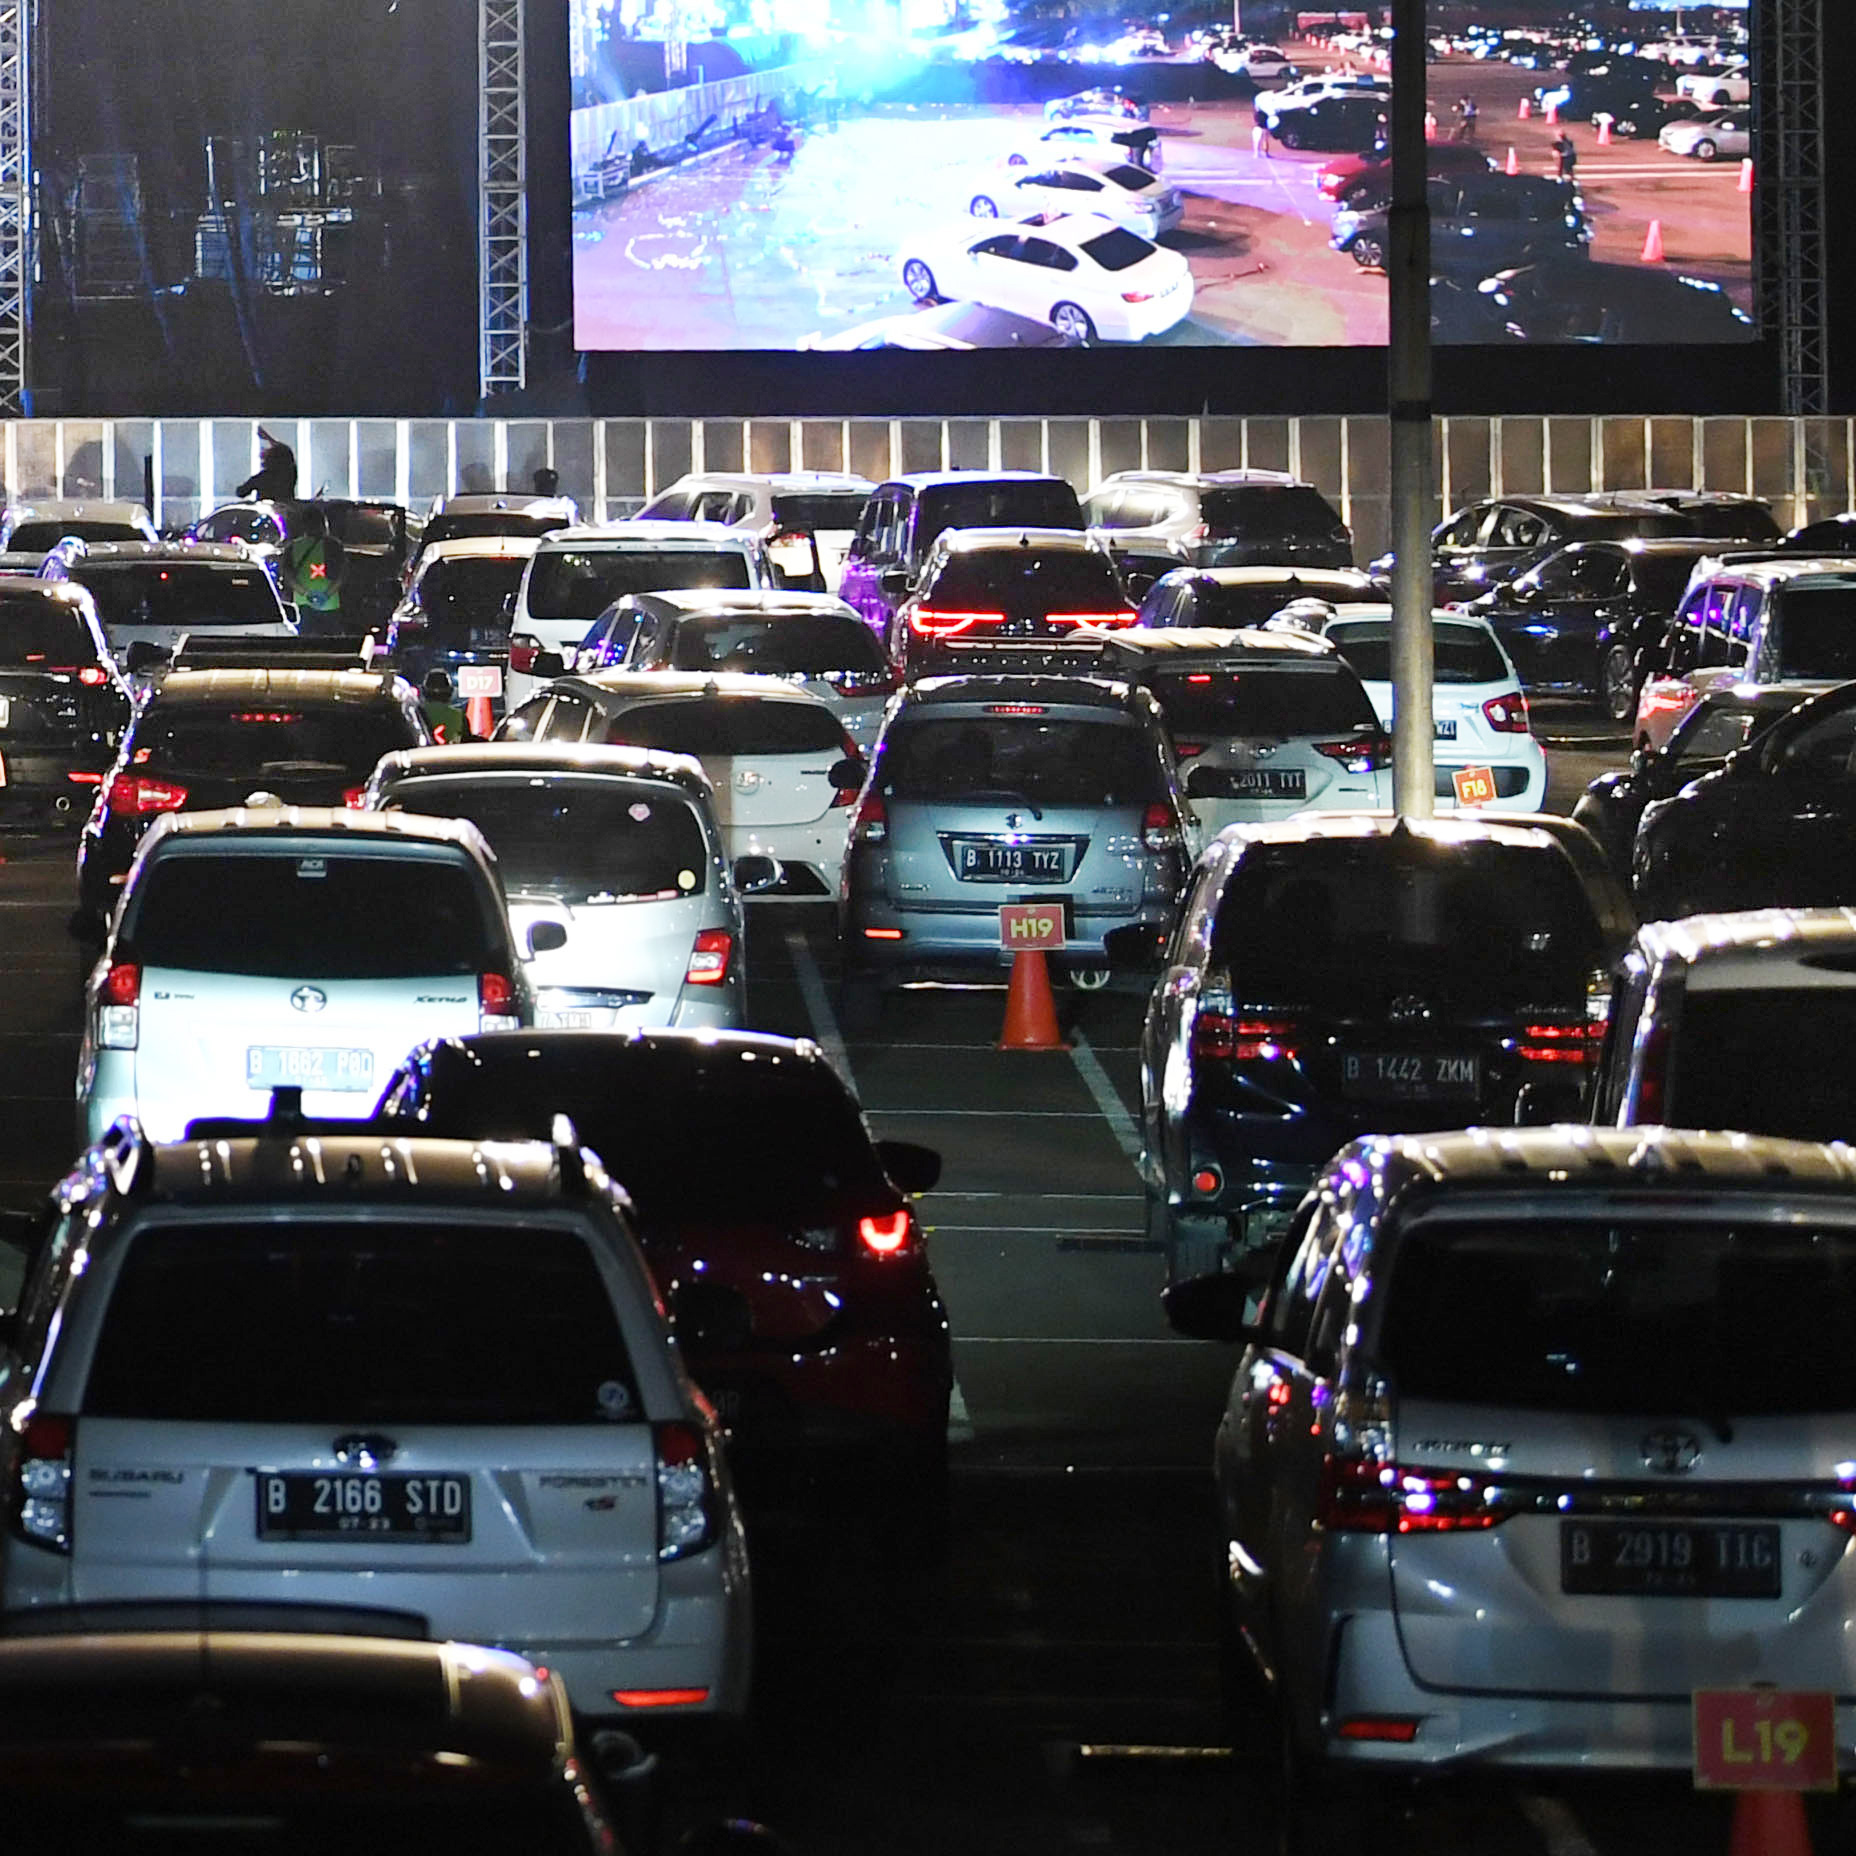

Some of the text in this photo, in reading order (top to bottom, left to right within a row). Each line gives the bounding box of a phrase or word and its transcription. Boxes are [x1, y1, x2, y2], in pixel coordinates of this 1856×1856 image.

[466, 674, 494, 689] D17
[1462, 778, 1488, 799] F18
[967, 848, 1059, 870] B 1113 TYZ
[1011, 918, 1054, 938] H19
[1347, 1056, 1474, 1082] B 1442 ZKM
[268, 1479, 462, 1515] B 2166 STD
[1573, 1529, 1590, 1565] B
[1616, 1531, 1693, 1567] 2919
[1722, 1718, 1809, 1765] L19
